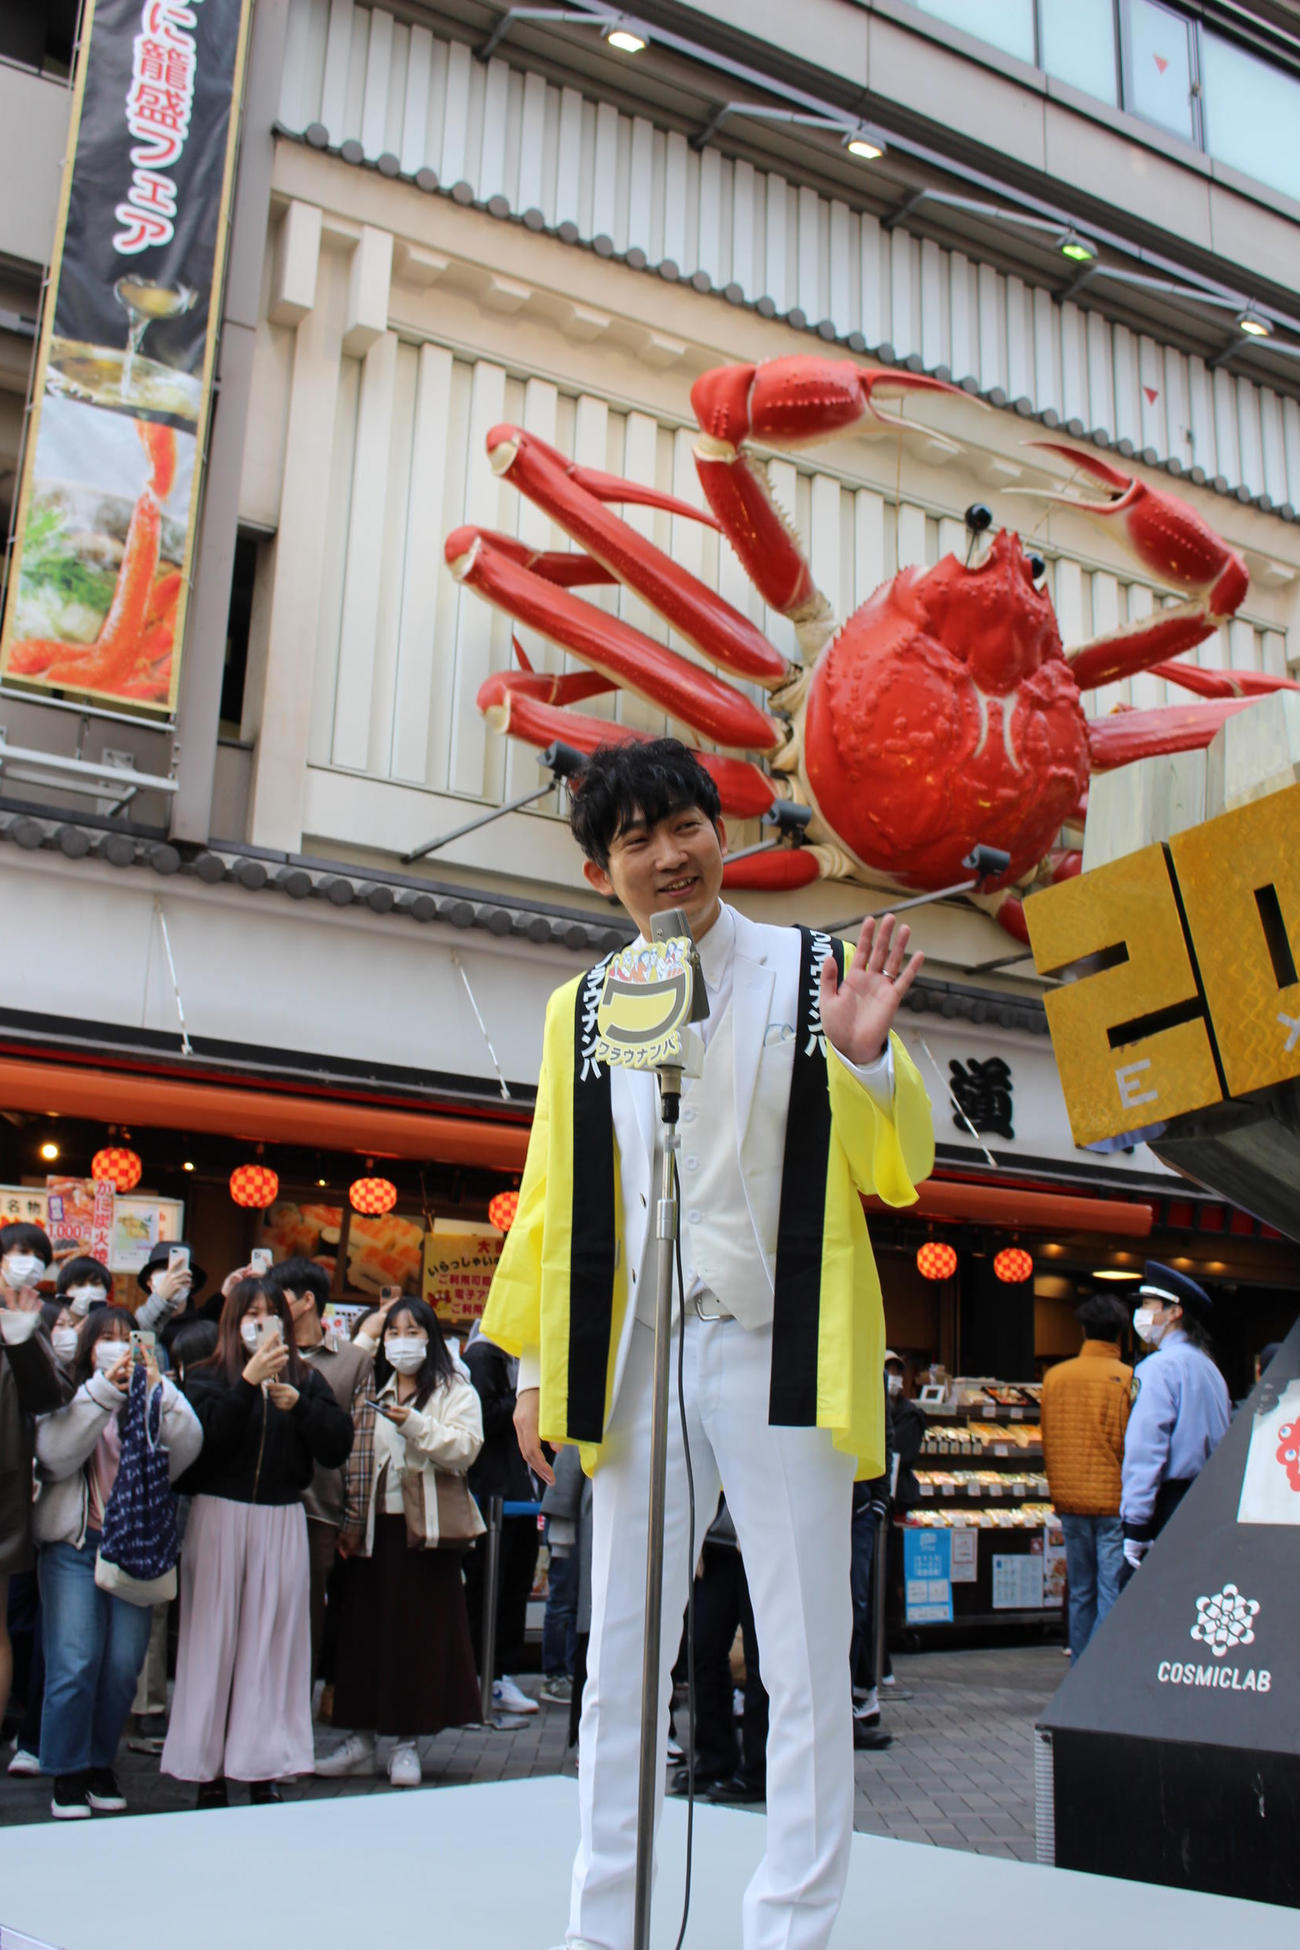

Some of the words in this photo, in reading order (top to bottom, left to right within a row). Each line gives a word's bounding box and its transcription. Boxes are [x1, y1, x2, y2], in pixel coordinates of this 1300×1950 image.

[116, 0, 198, 250] に籠盛フェア
[598, 1035, 676, 1064] ワラウナンバ
[1157, 1660, 1272, 1692] COSMICLAB
